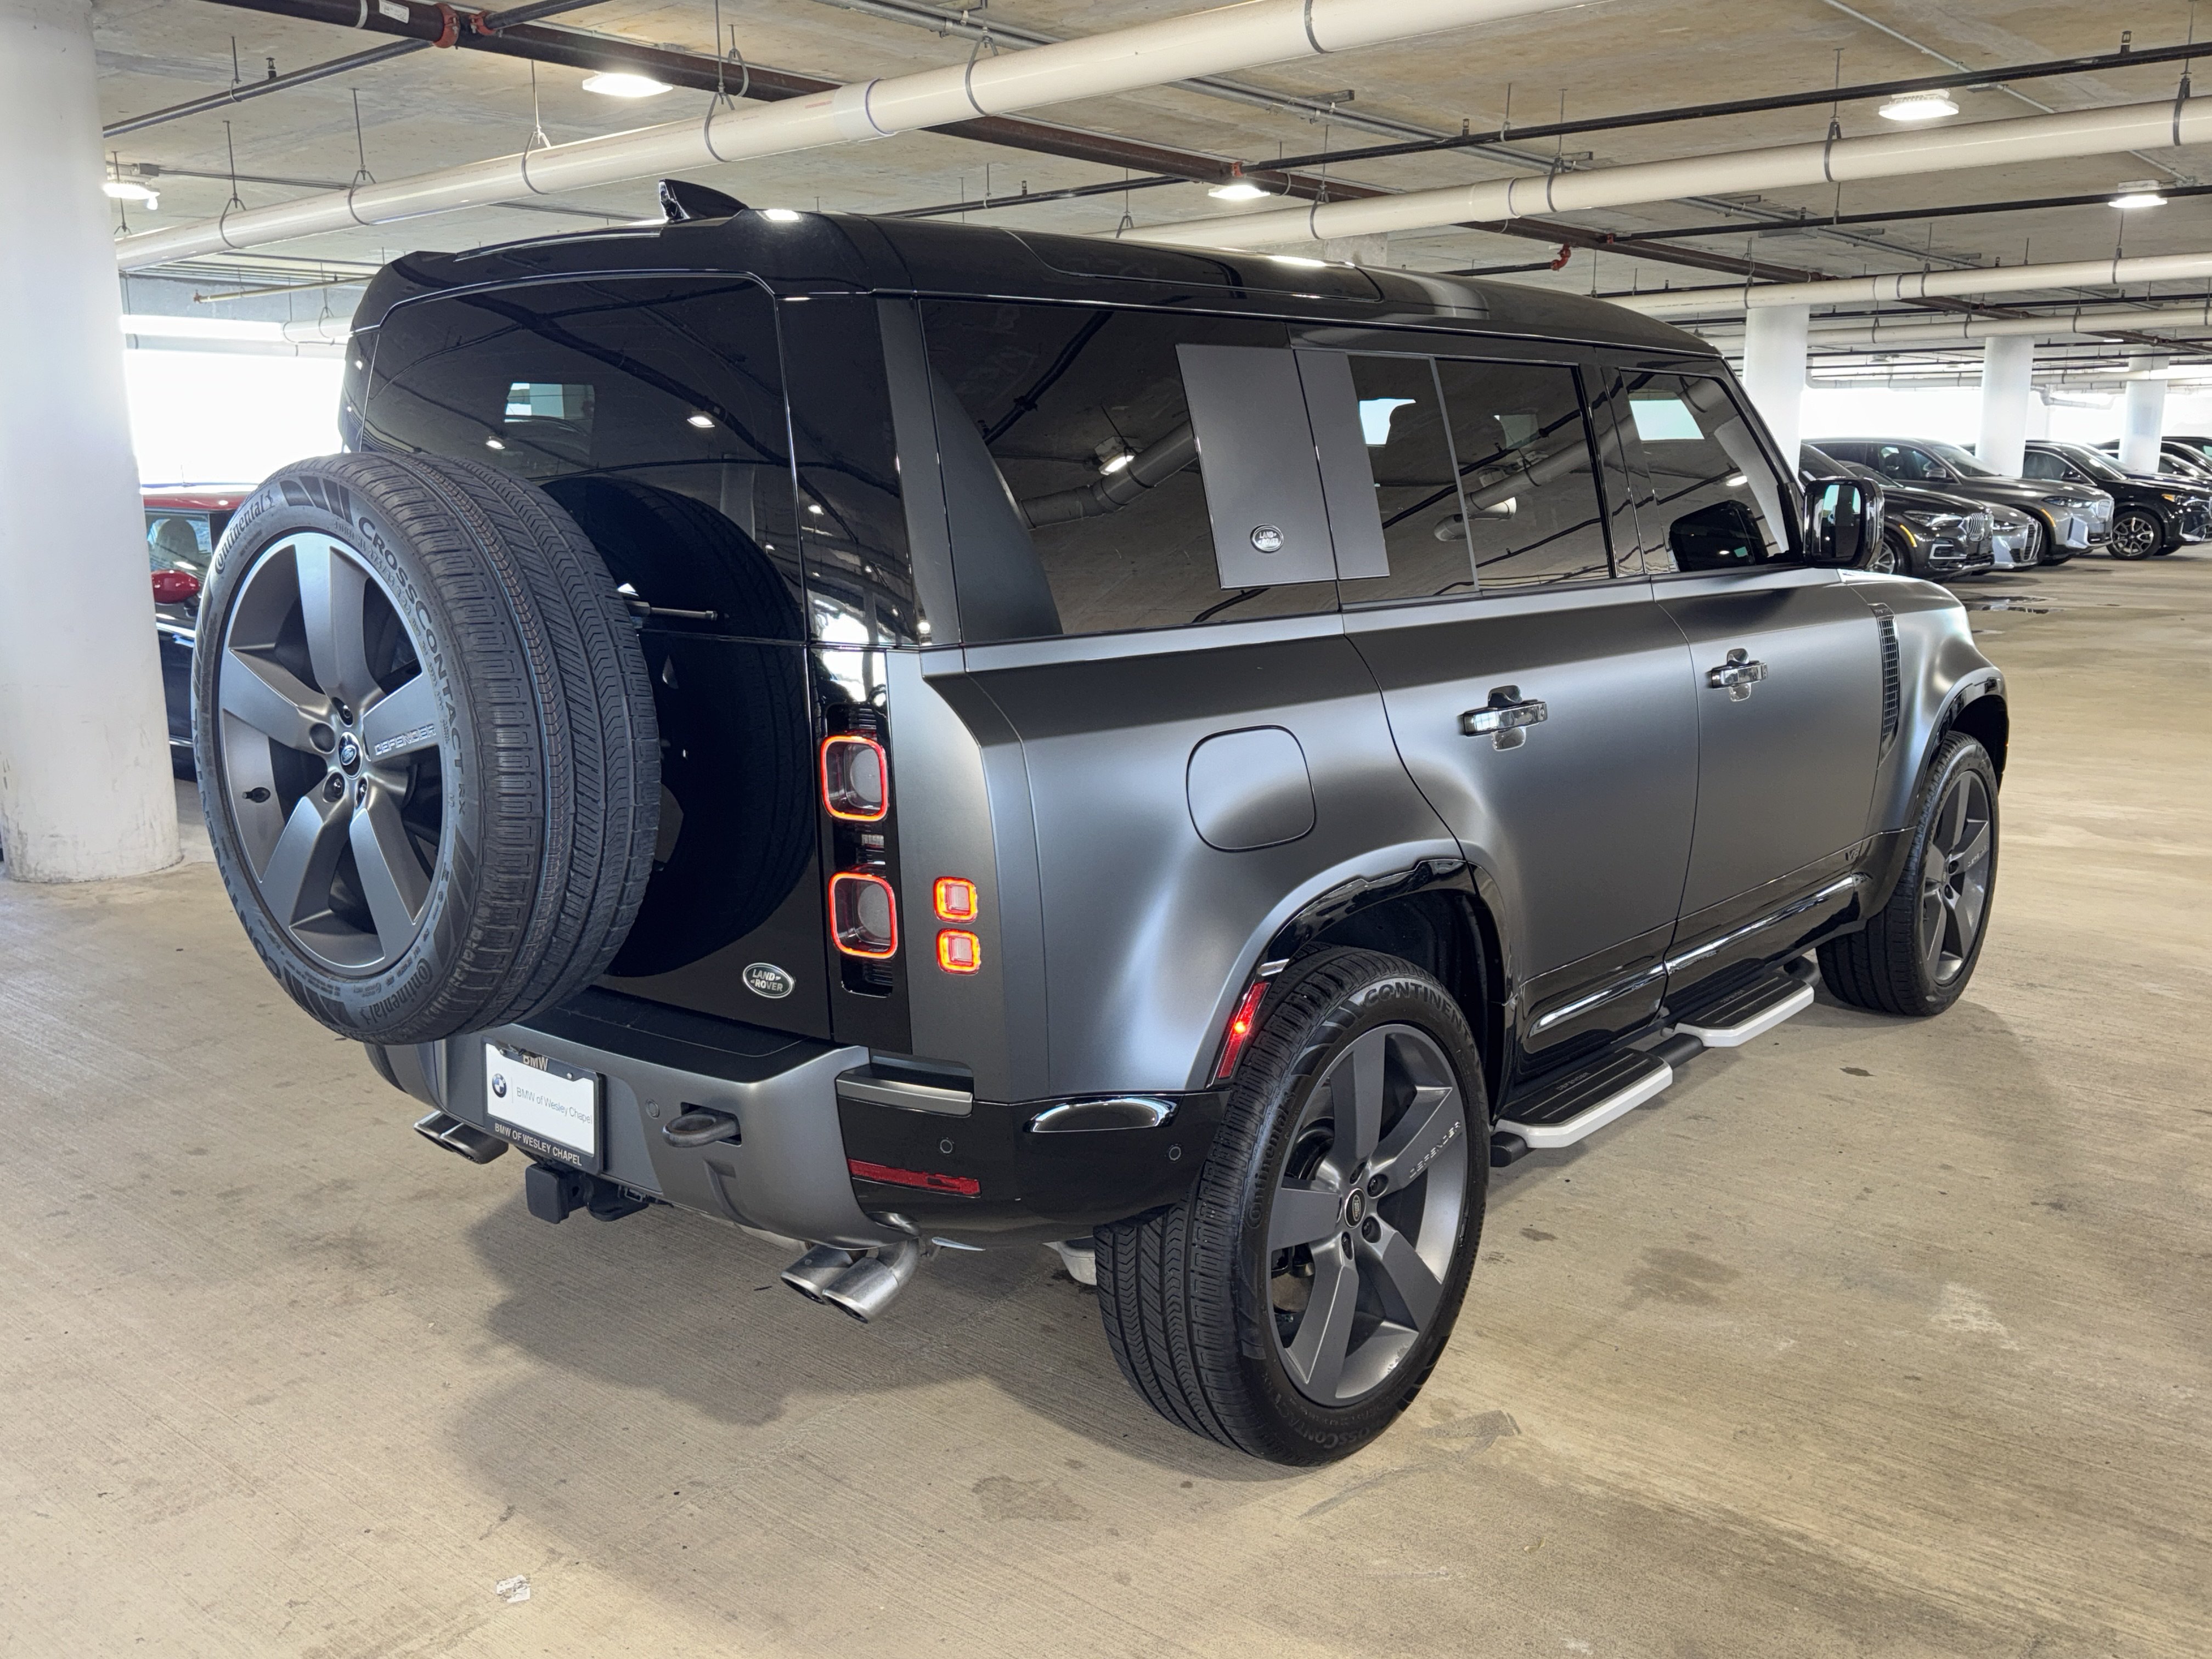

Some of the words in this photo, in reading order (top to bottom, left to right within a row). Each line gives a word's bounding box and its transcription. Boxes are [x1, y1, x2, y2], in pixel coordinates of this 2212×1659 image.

[215, 494, 265, 574] Continental
[375, 723, 436, 755] DEFENDER
[368, 958, 432, 1024] Continental
[753, 969, 775, 981] LAND
[755, 979, 783, 992] ROVER
[522, 1054, 549, 1071] BMW
[517, 1087, 535, 1102] BMW
[536, 1096, 543, 1105] of
[543, 1096, 568, 1116] Wesley
[569, 1107, 592, 1124] Chapel
[495, 1122, 511, 1137] BMW
[512, 1130, 522, 1141] OF
[522, 1133, 551, 1153] WESLEY
[552, 1147, 582, 1166] CHAPEL
[1409, 1121, 1461, 1179] DEFENDER
